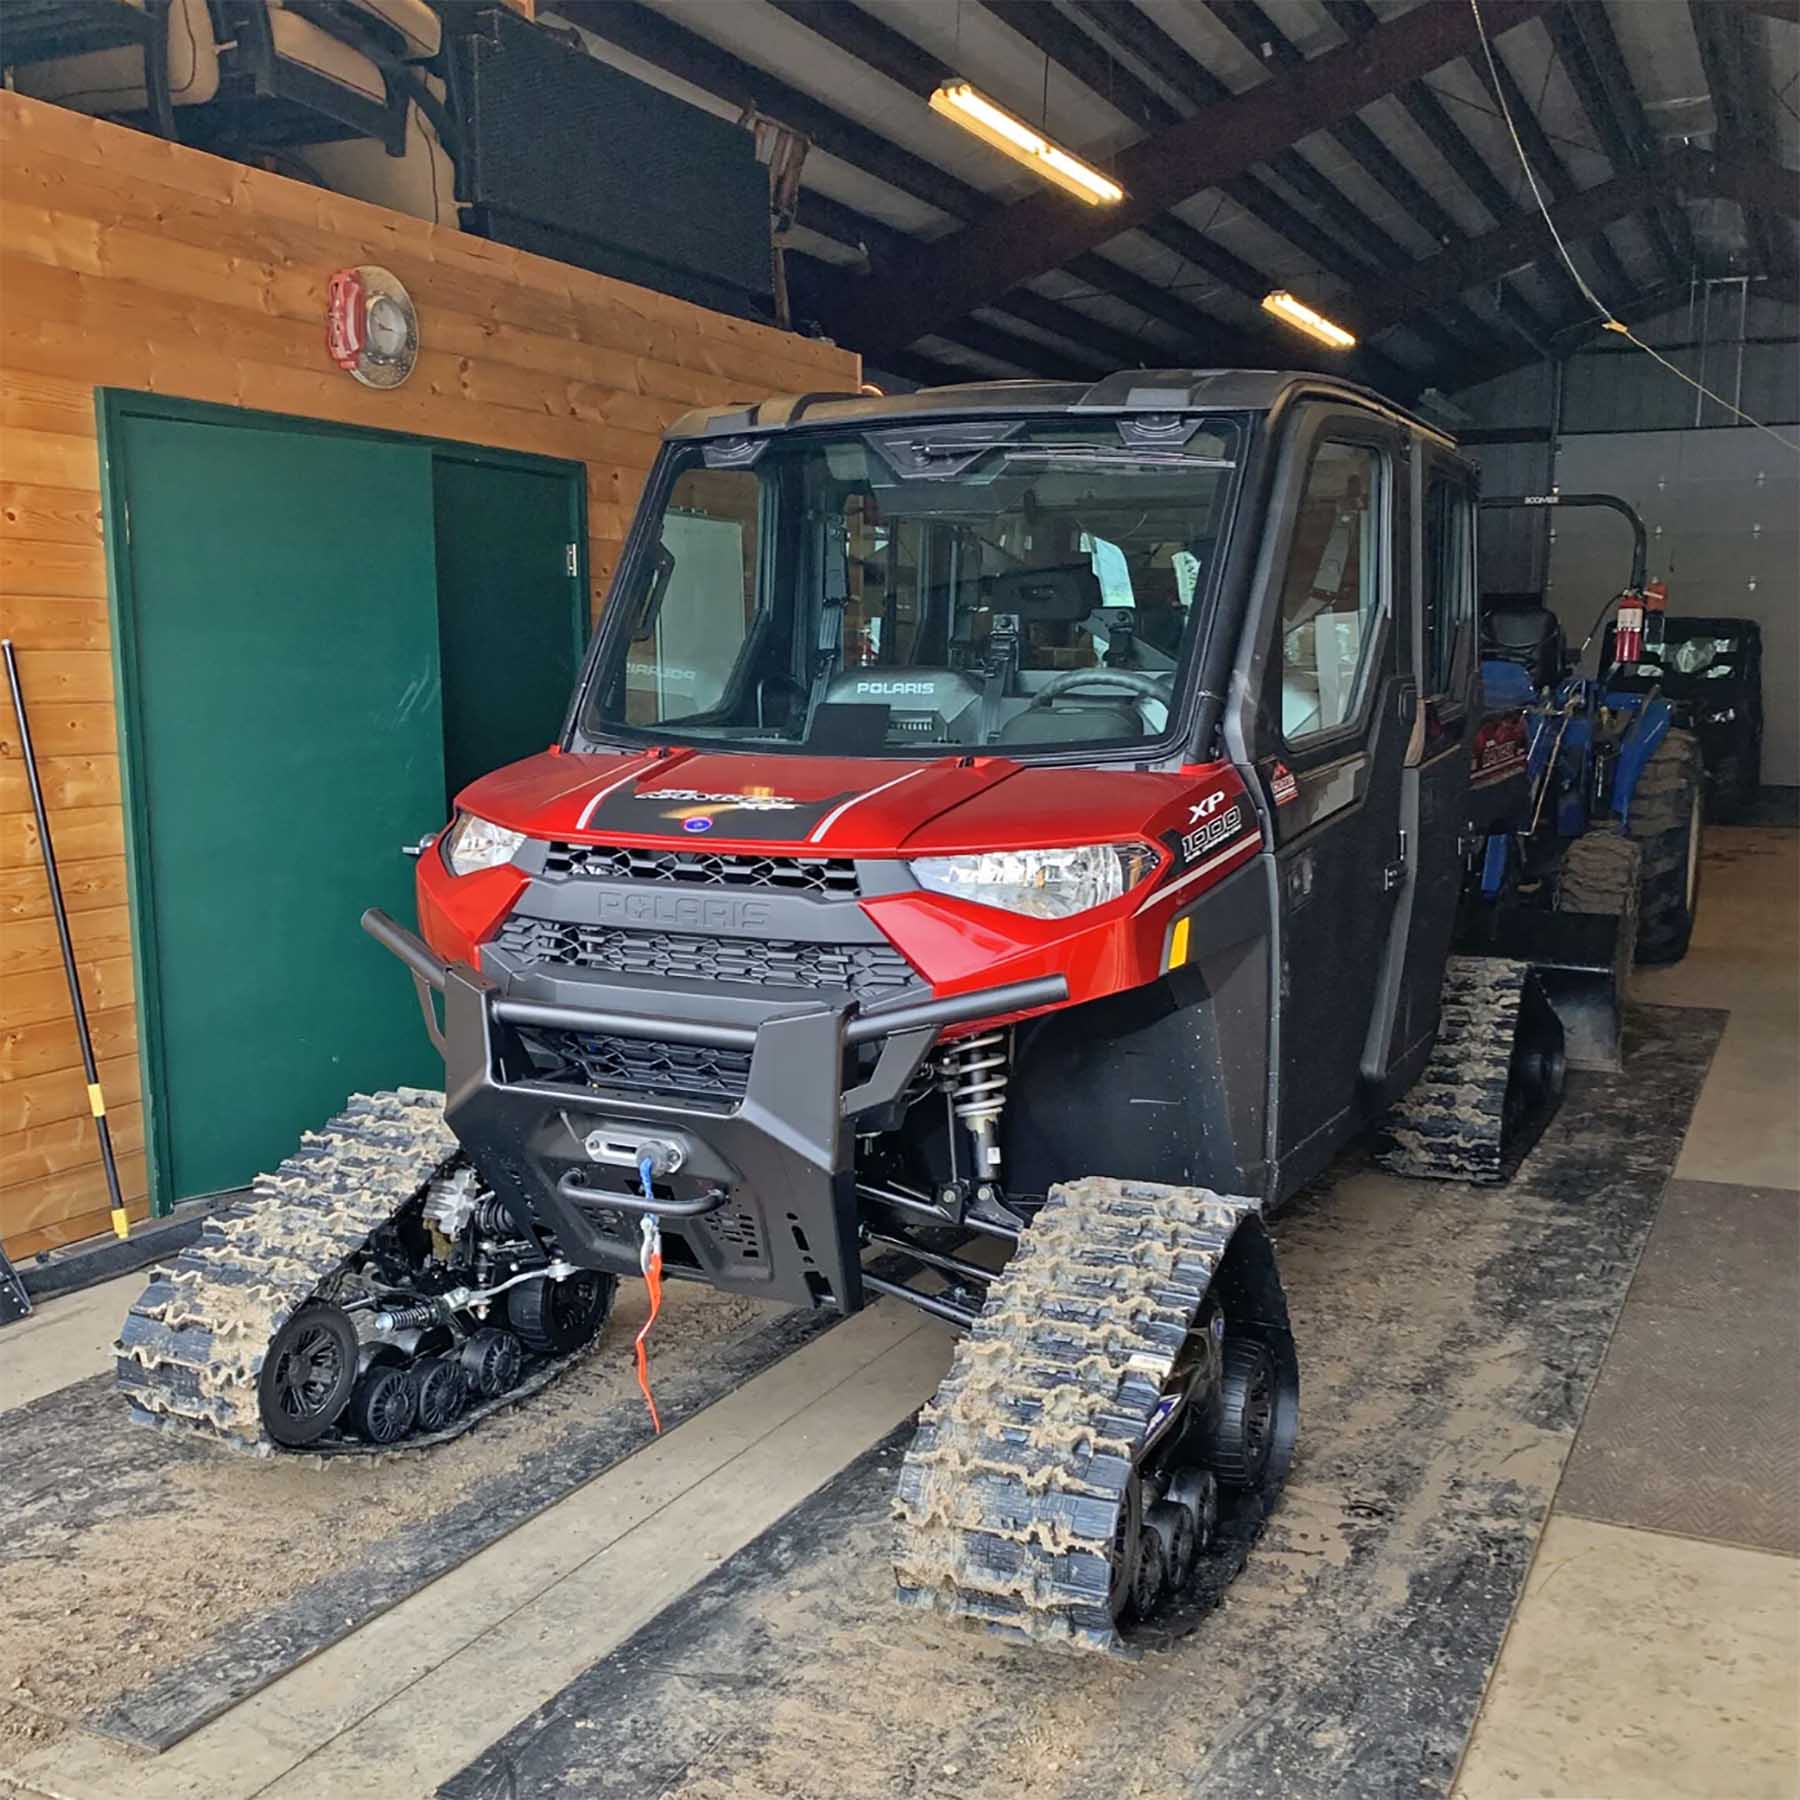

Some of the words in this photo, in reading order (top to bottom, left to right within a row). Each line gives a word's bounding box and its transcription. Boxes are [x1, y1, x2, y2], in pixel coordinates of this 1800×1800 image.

[857, 682, 935, 695] POLARIS
[1188, 790, 1225, 825] XP
[1181, 805, 1242, 857] 1000
[598, 890, 771, 929] POLARIS
